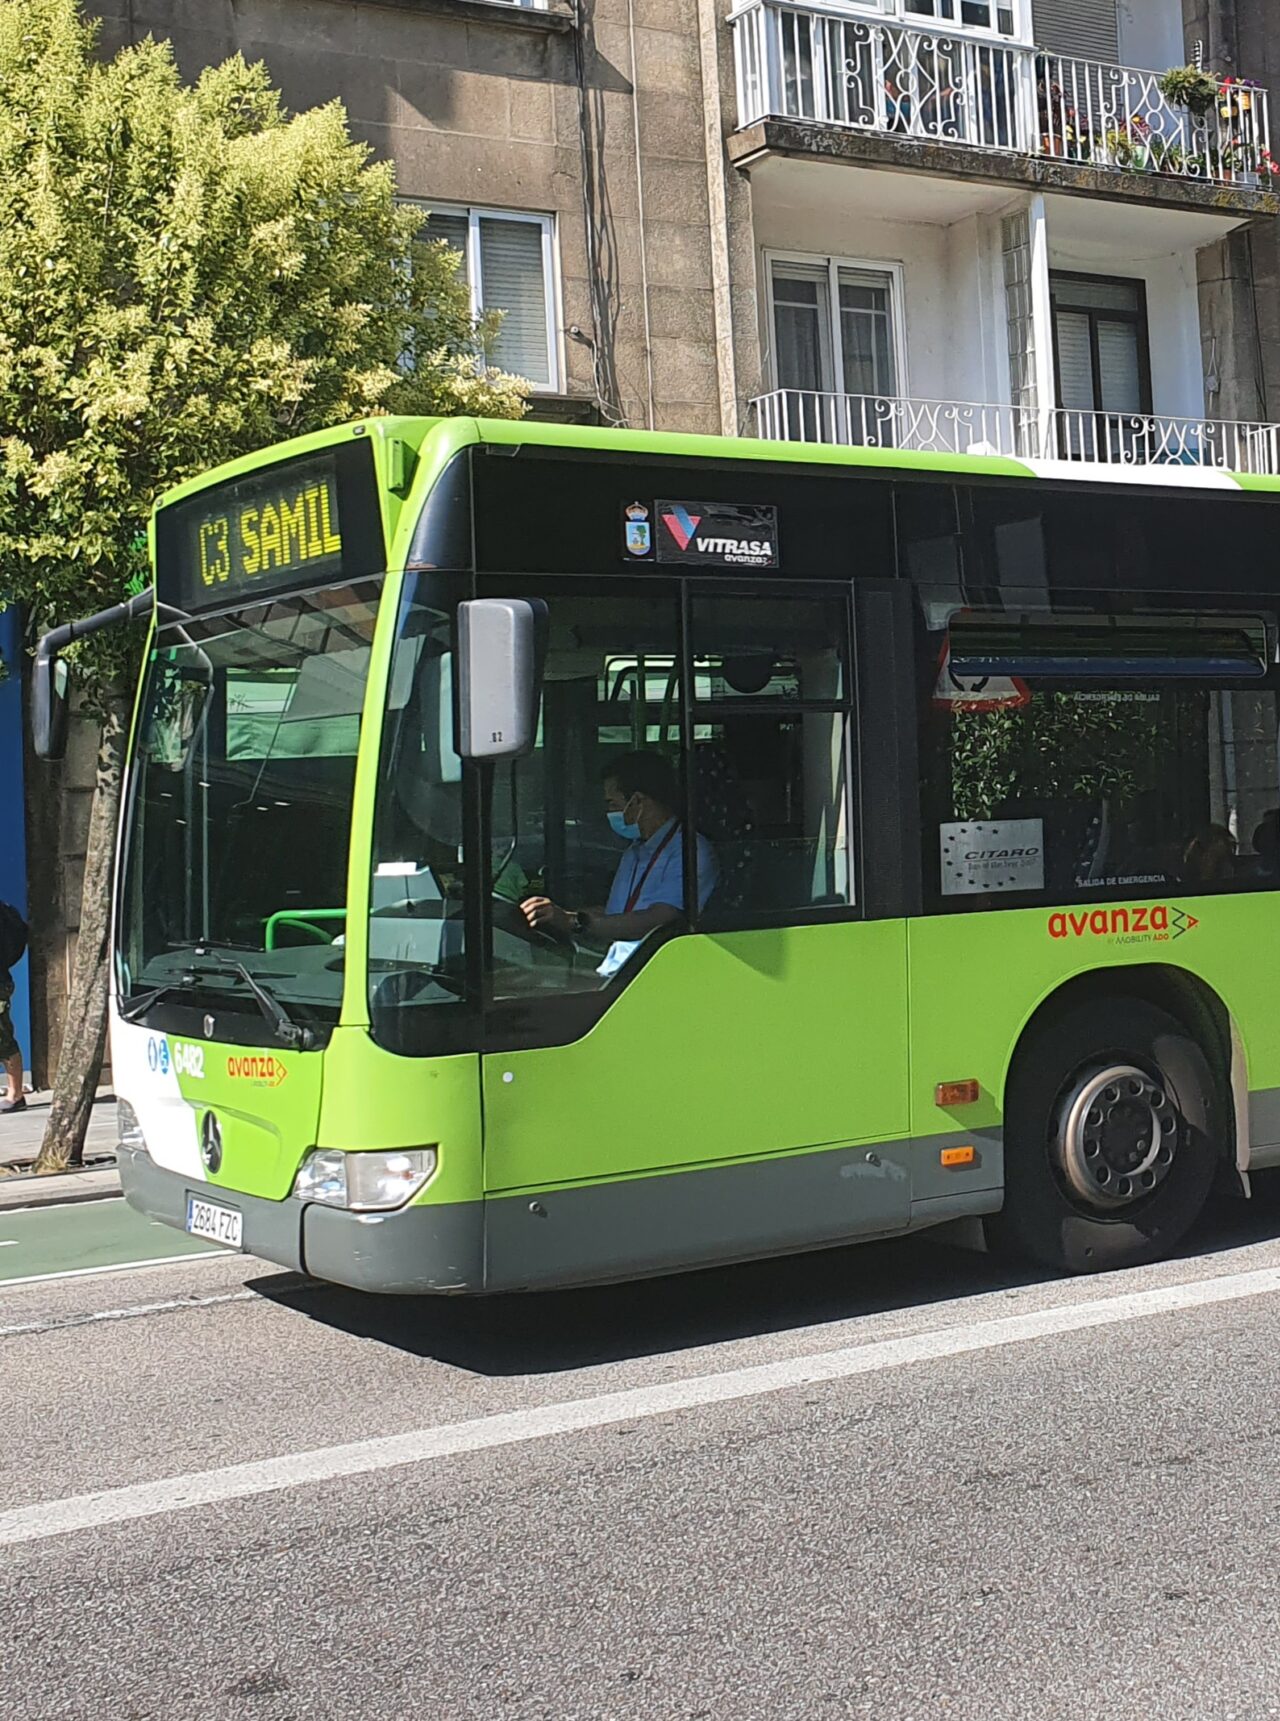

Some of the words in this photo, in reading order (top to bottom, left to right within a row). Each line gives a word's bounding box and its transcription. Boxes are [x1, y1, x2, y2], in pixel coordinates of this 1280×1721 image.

[199, 517, 231, 586] C3
[240, 483, 342, 574] SAMIL
[696, 537, 772, 556] VITRASA
[724, 555, 763, 564] avanza
[964, 847, 1039, 860] CITARO
[1048, 905, 1168, 939] avanza
[1153, 933, 1169, 942] ADO
[174, 1041, 205, 1079] 6482
[227, 1056, 275, 1077] avanza
[193, 1204, 217, 1235] 2684
[219, 1211, 239, 1242] FZC
